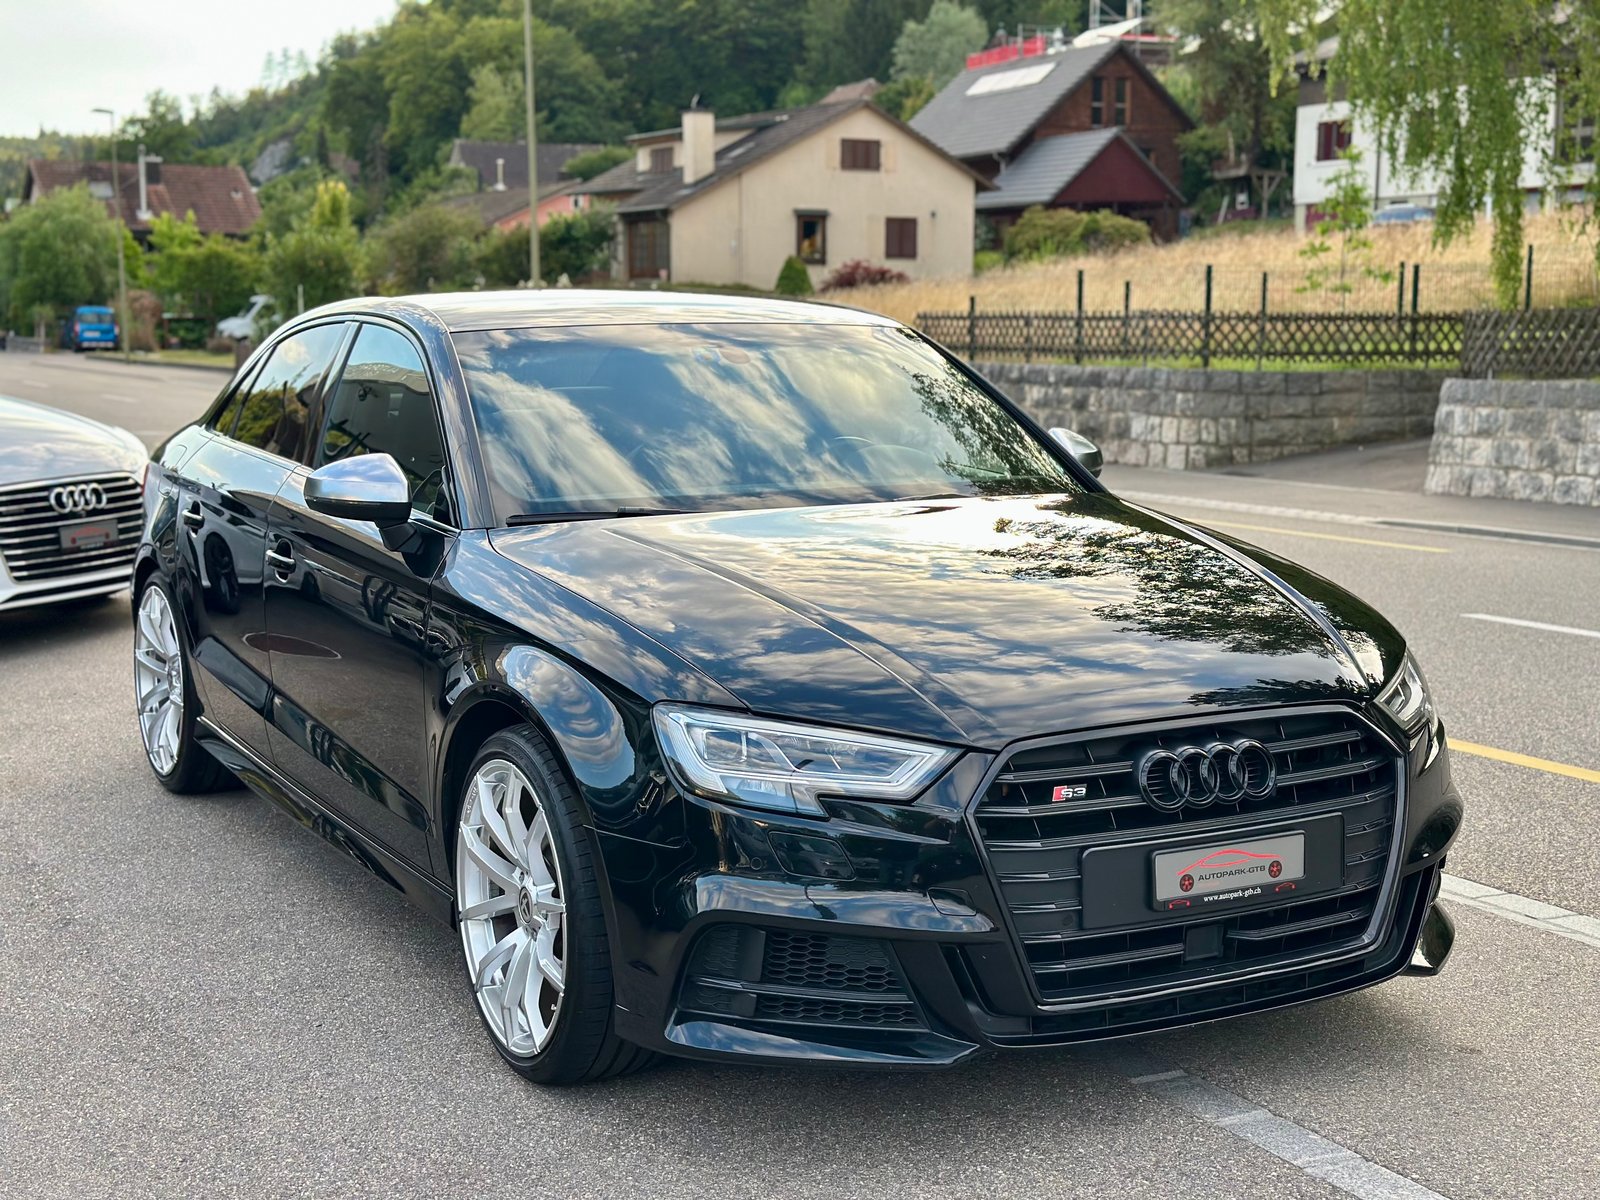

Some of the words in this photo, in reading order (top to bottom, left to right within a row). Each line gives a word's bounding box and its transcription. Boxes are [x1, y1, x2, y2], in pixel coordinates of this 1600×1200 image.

[1060, 787, 1087, 798] S3
[1198, 865, 1266, 881] AUTOPARK-GTB
[1203, 887, 1261, 902] www.autopark-gtb.ch
